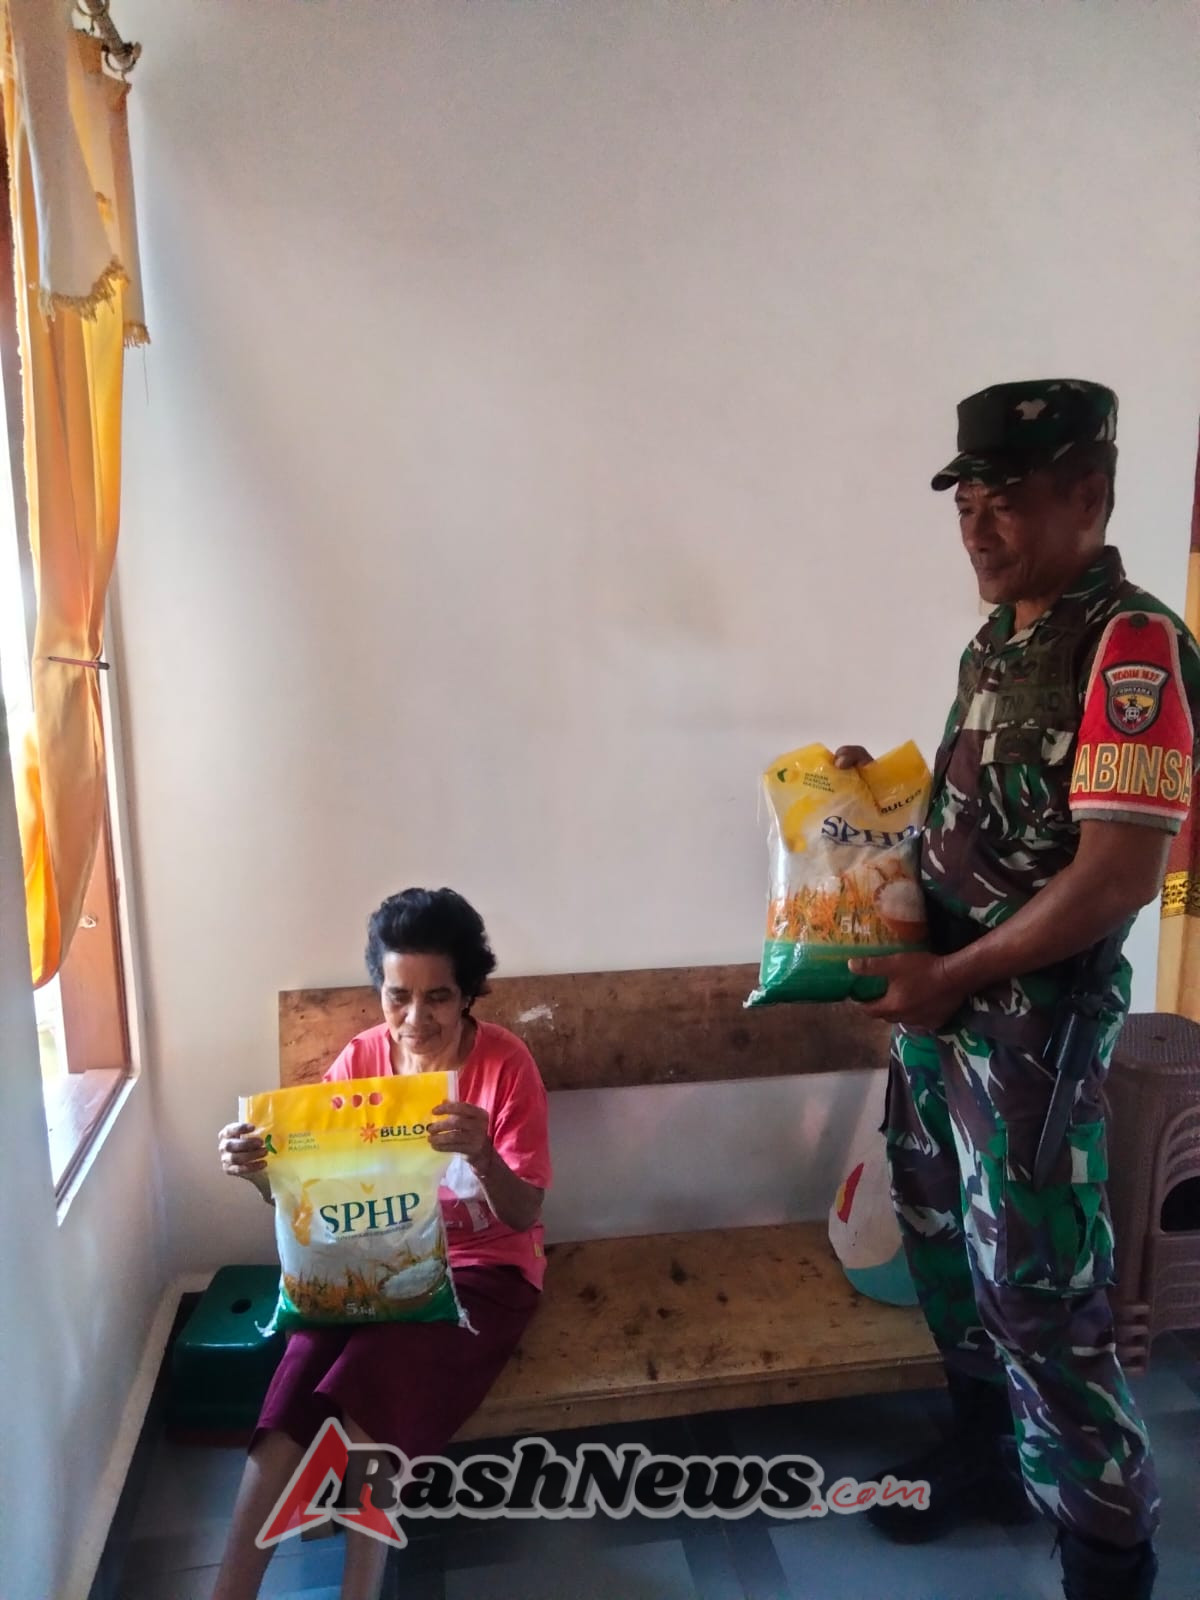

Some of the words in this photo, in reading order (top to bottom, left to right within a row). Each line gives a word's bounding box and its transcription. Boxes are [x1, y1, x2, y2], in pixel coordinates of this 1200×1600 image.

[1070, 743, 1192, 807] ABINSA
[840, 916, 852, 934] 5
[319, 1192, 420, 1234] SPHP
